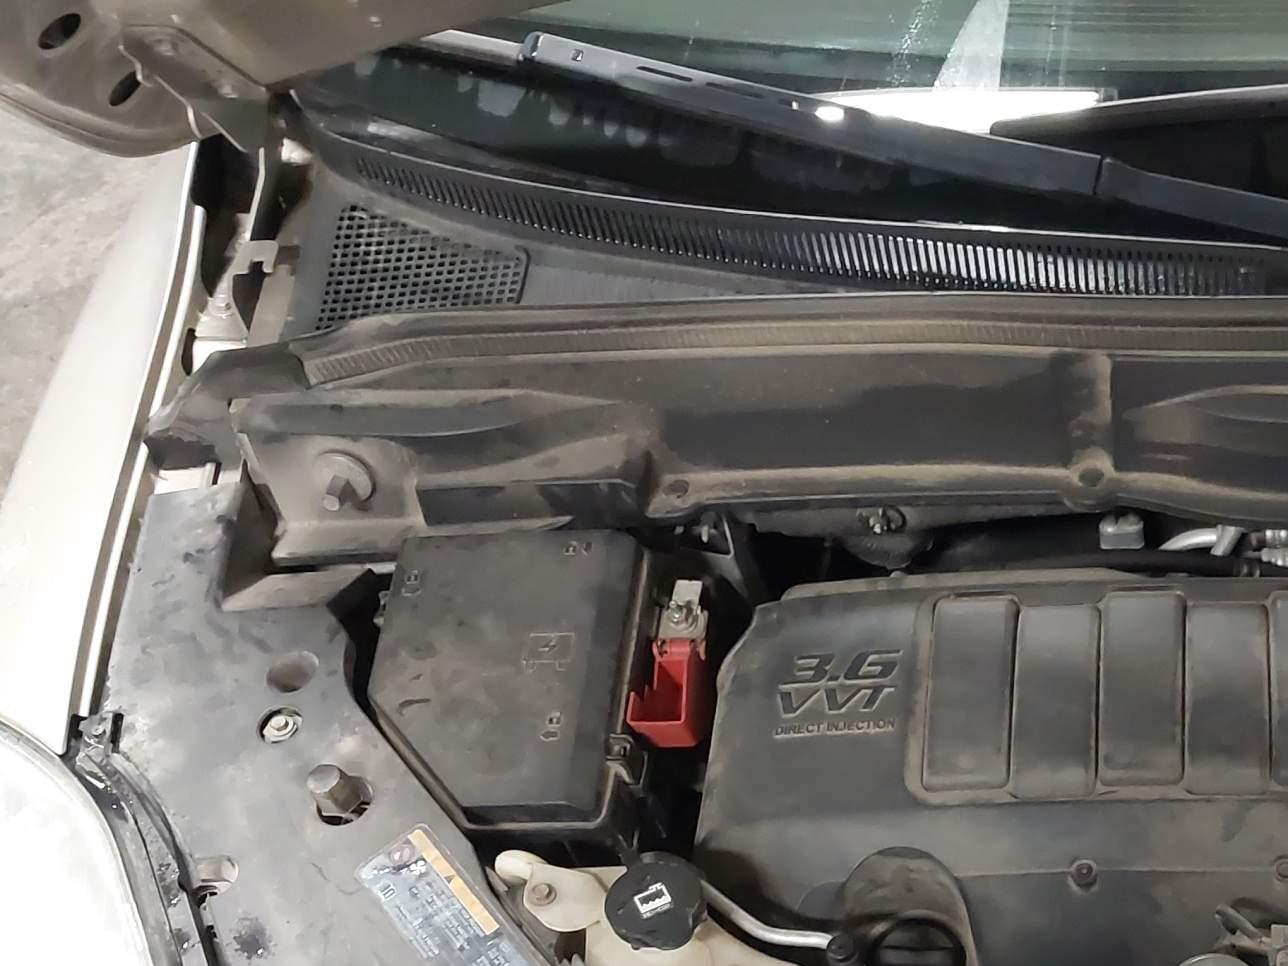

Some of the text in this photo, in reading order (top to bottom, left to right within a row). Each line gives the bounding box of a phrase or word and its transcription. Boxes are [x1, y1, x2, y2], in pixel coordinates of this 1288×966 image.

[779, 649, 903, 685] 3.6
[778, 685, 897, 717] VVT
[775, 719, 896, 737] DIRECT INJECTION
